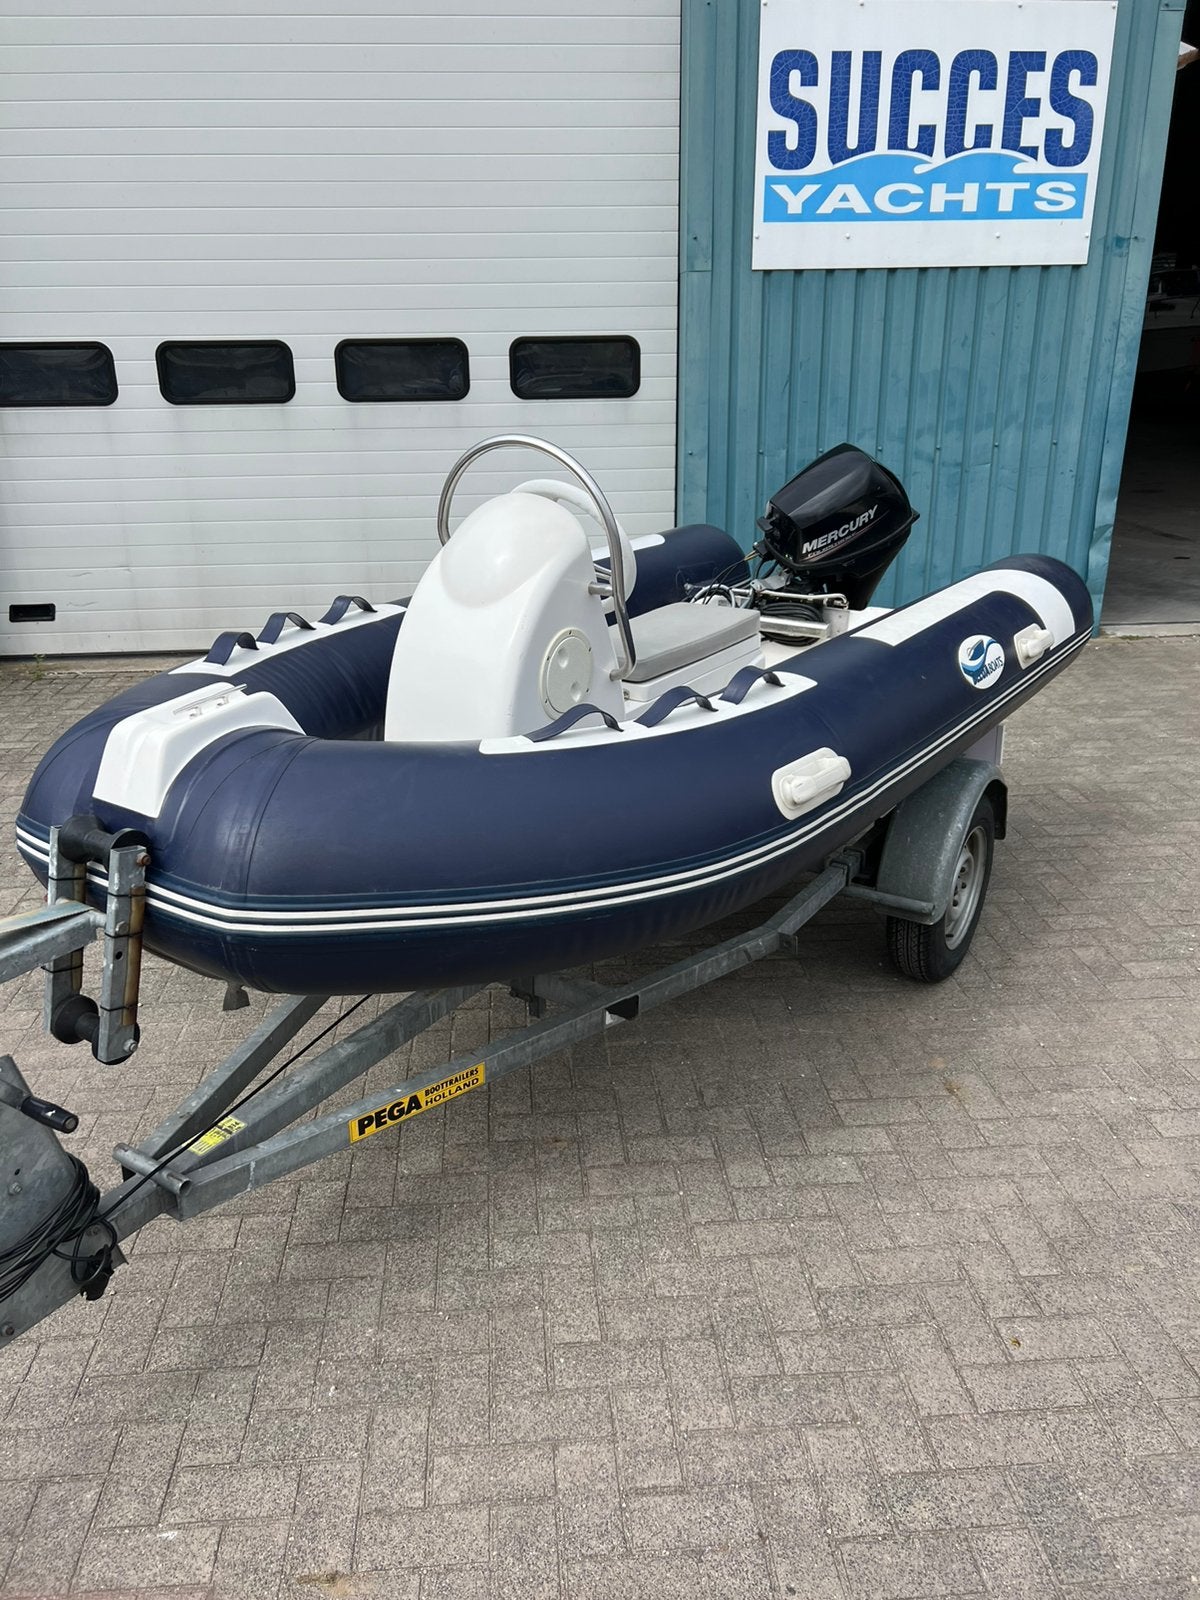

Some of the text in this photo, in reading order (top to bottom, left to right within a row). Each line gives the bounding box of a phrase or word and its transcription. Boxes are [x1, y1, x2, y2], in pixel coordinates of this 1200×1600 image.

[768, 49, 1098, 170] SUCCES
[770, 181, 1077, 214] YACHTS
[802, 504, 878, 554] MERCURY
[424, 1067, 479, 1096] BOOTTRAILERS
[424, 1077, 480, 1107] HOLLAND
[357, 1094, 423, 1137] PEGA
